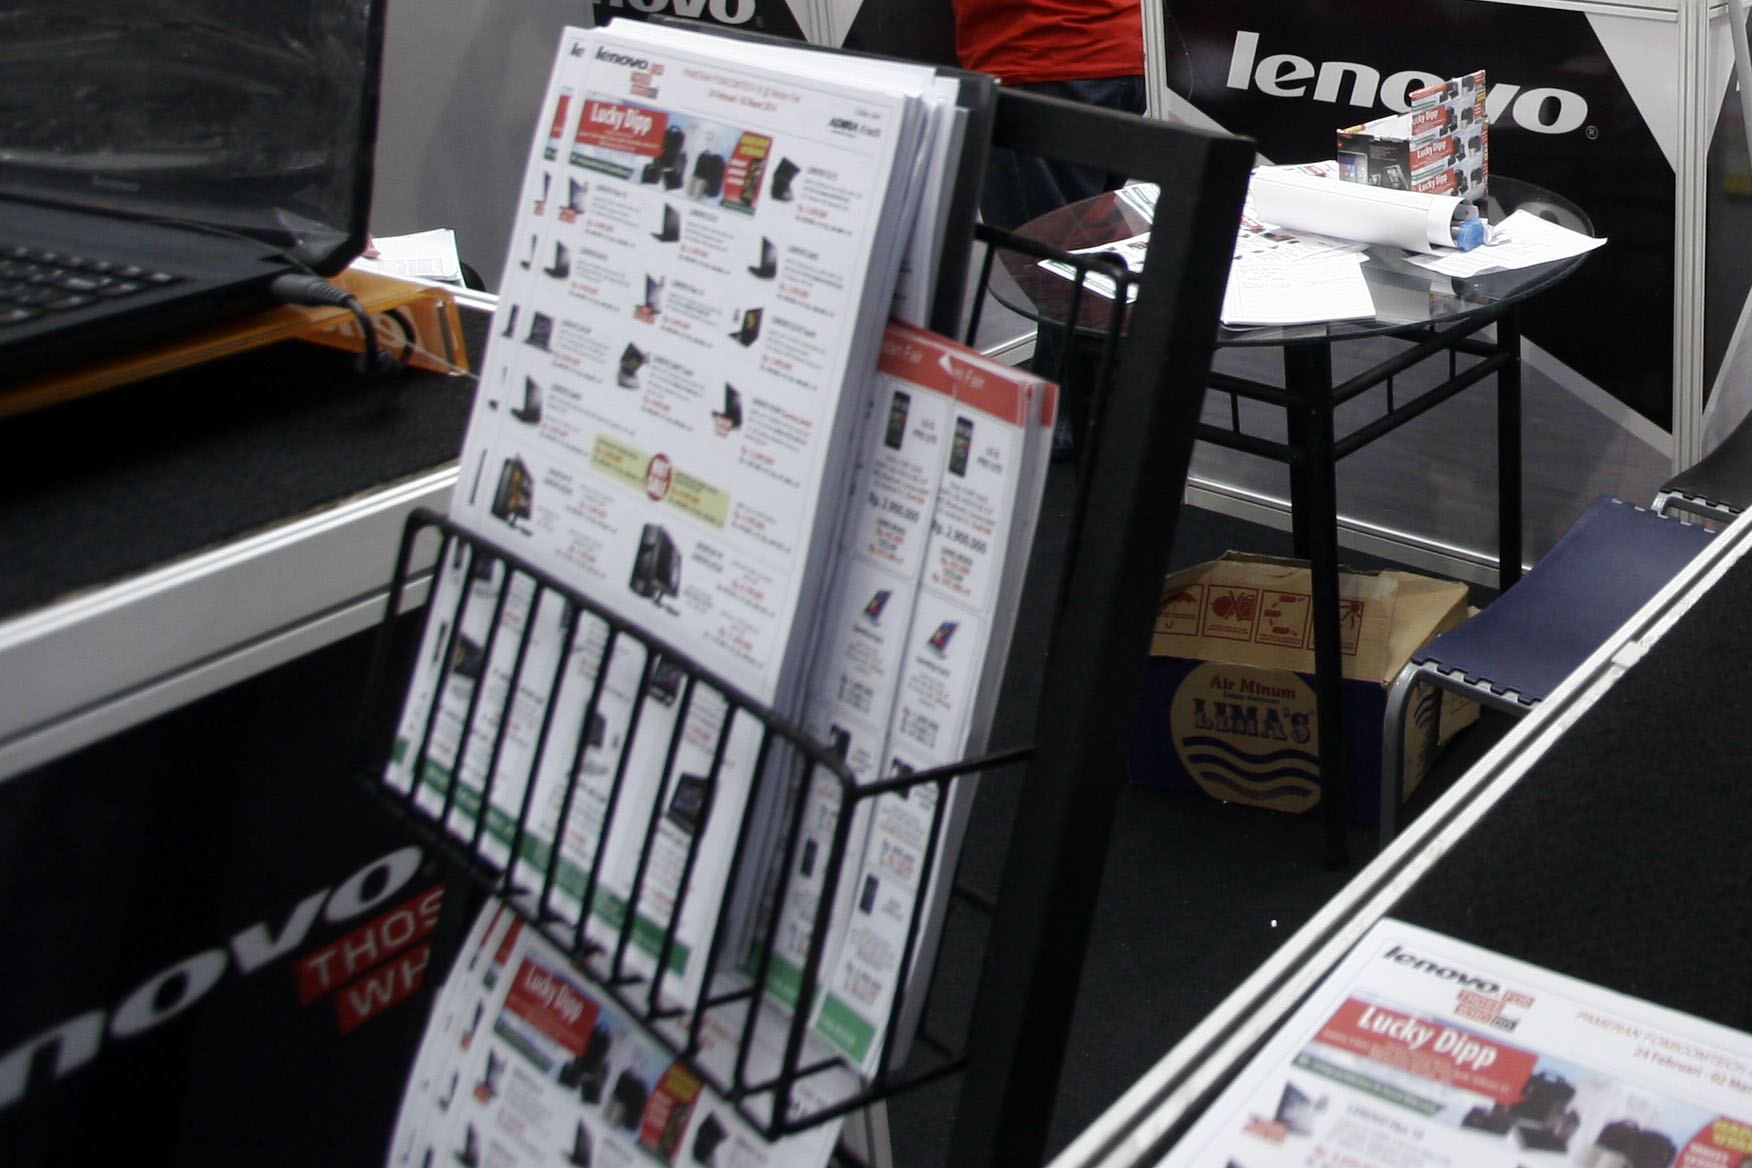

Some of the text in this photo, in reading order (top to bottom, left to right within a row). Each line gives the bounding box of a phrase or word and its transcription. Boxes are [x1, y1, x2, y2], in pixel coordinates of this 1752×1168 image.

[595, 46, 649, 71] lenovo
[590, 103, 654, 137] Lucky Dipp
[1416, 140, 1447, 159] Lucky Dipp
[1418, 173, 1449, 192] Lucky Dipp
[1209, 674, 1297, 701] Air Minum
[1192, 697, 1312, 745] LIMA'S
[1383, 944, 1501, 995] lenovo
[523, 965, 585, 1024] Lucky Dipp
[1358, 1005, 1435, 1049] Lucky
[1434, 1025, 1499, 1071] Dipp
